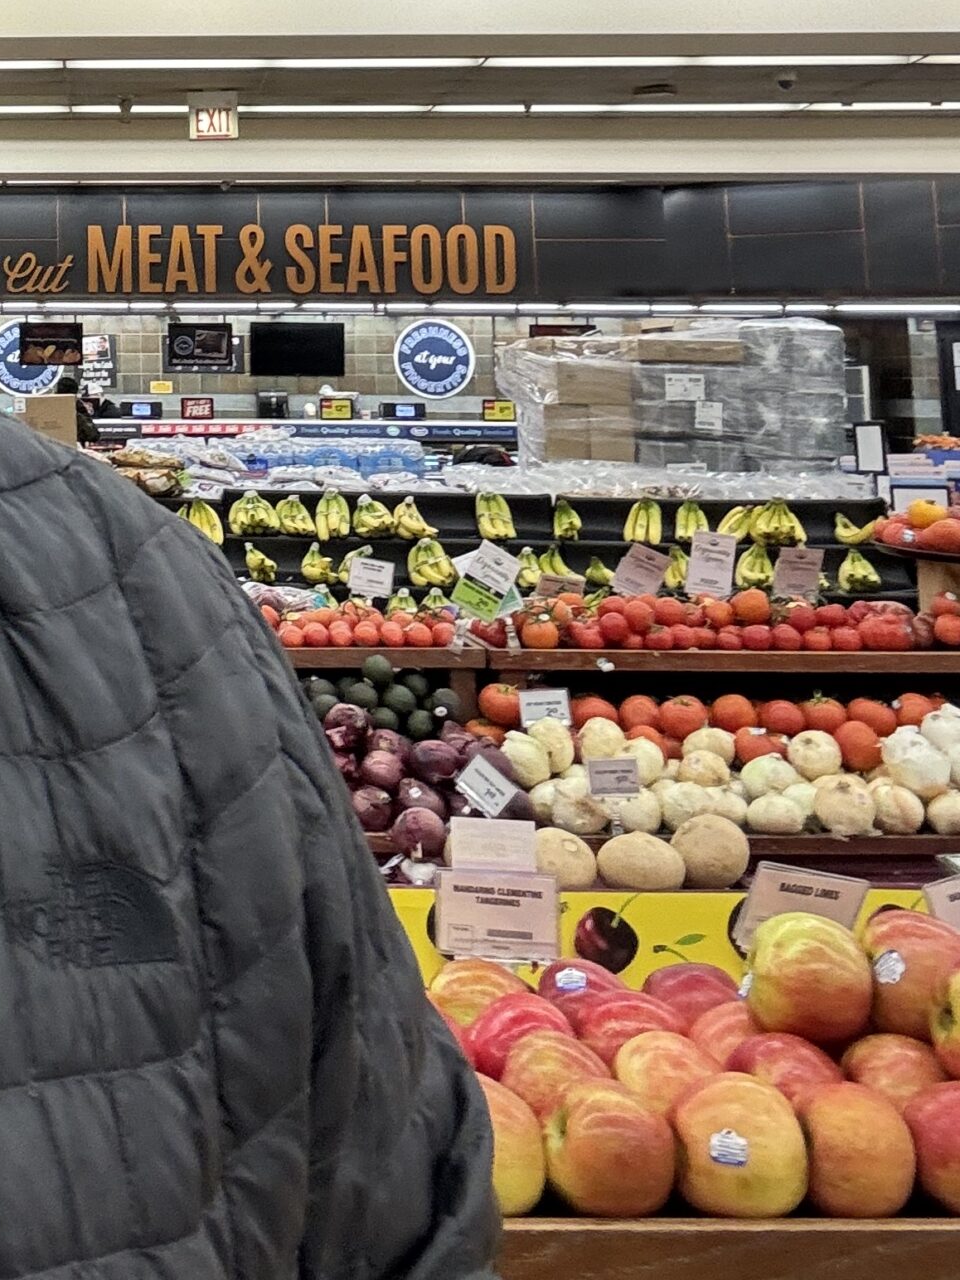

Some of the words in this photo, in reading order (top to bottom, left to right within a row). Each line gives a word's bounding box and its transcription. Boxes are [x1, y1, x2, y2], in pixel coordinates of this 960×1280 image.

[196, 108, 232, 133] EXIT
[3, 251, 74, 293] Cut
[87, 224, 223, 294] MEAT
[235, 223, 273, 295] &
[284, 223, 517, 296] SEAFOOD
[400, 326, 468, 357] FRESHNESS
[413, 350, 430, 364] at
[428, 354, 457, 370] your
[400, 362, 467, 393] FINGERTIPS
[184, 404, 212, 417] FREE
[320, 426, 350, 435] Quality
[452, 426, 482, 436] Quality
[497, 888, 543, 899] CLEMENTINE
[779, 882, 814, 896] BAGGED
[814, 887, 841, 901] LIMES
